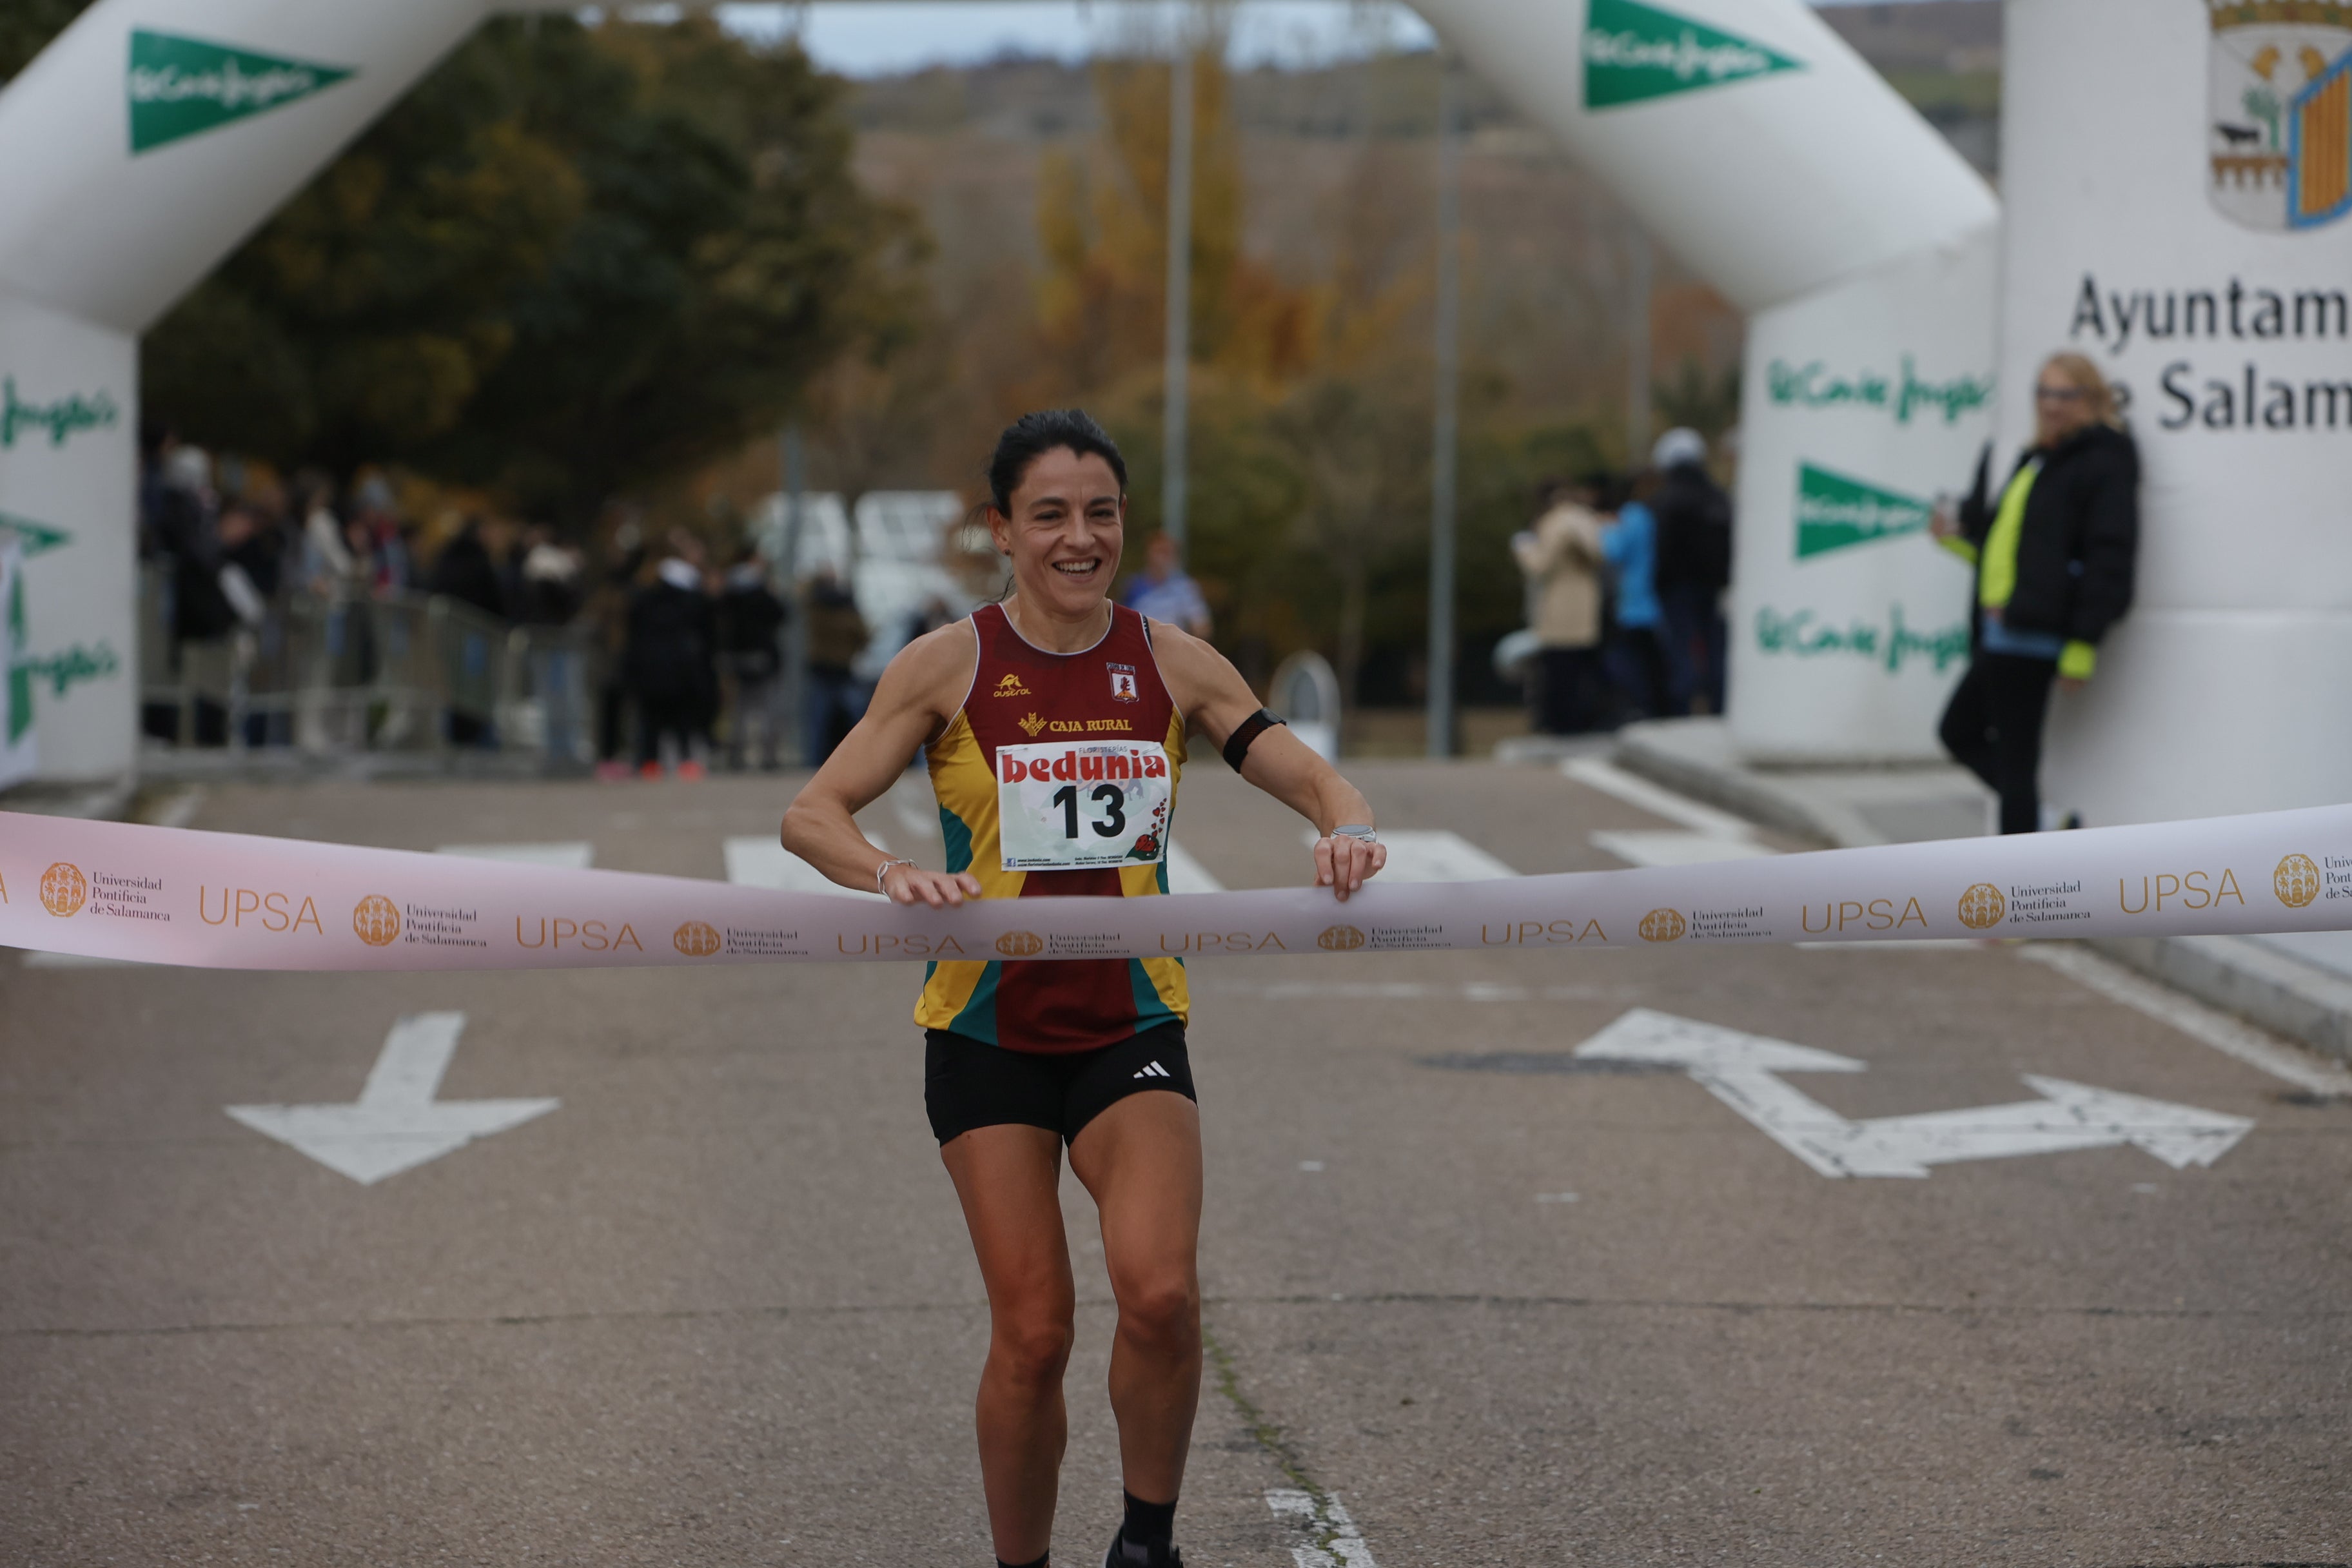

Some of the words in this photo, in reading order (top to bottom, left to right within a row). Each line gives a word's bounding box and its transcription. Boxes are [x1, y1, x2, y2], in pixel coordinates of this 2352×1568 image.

[1050, 720, 1084, 732] CAJA
[1086, 718, 1132, 732] RURAL
[1003, 749, 1166, 784] bedunia
[1054, 784, 1126, 839] 13
[93, 872, 162, 890] Universidad
[2011, 880, 2081, 898] Universidad
[92, 887, 147, 904] Pontificia
[2119, 868, 2246, 914] UPSA
[2326, 887, 2340, 899] de
[90, 902, 104, 915] de
[106, 903, 170, 921] Salamanca
[200, 885, 323, 934] UPSA
[407, 904, 476, 922] Universidad
[2011, 897, 2066, 911] Pontificia
[1802, 897, 1928, 934] UPSA
[2010, 914, 2024, 923] de
[2026, 912, 2091, 923] Salamanca
[406, 918, 462, 934] Pontificia
[515, 916, 644, 952] UPSA
[1481, 919, 1608, 946] UPSA
[405, 932, 420, 943] de
[422, 934, 487, 948] Salamanca
[838, 933, 965, 955] UPSA
[1161, 930, 1286, 952] UPSA
